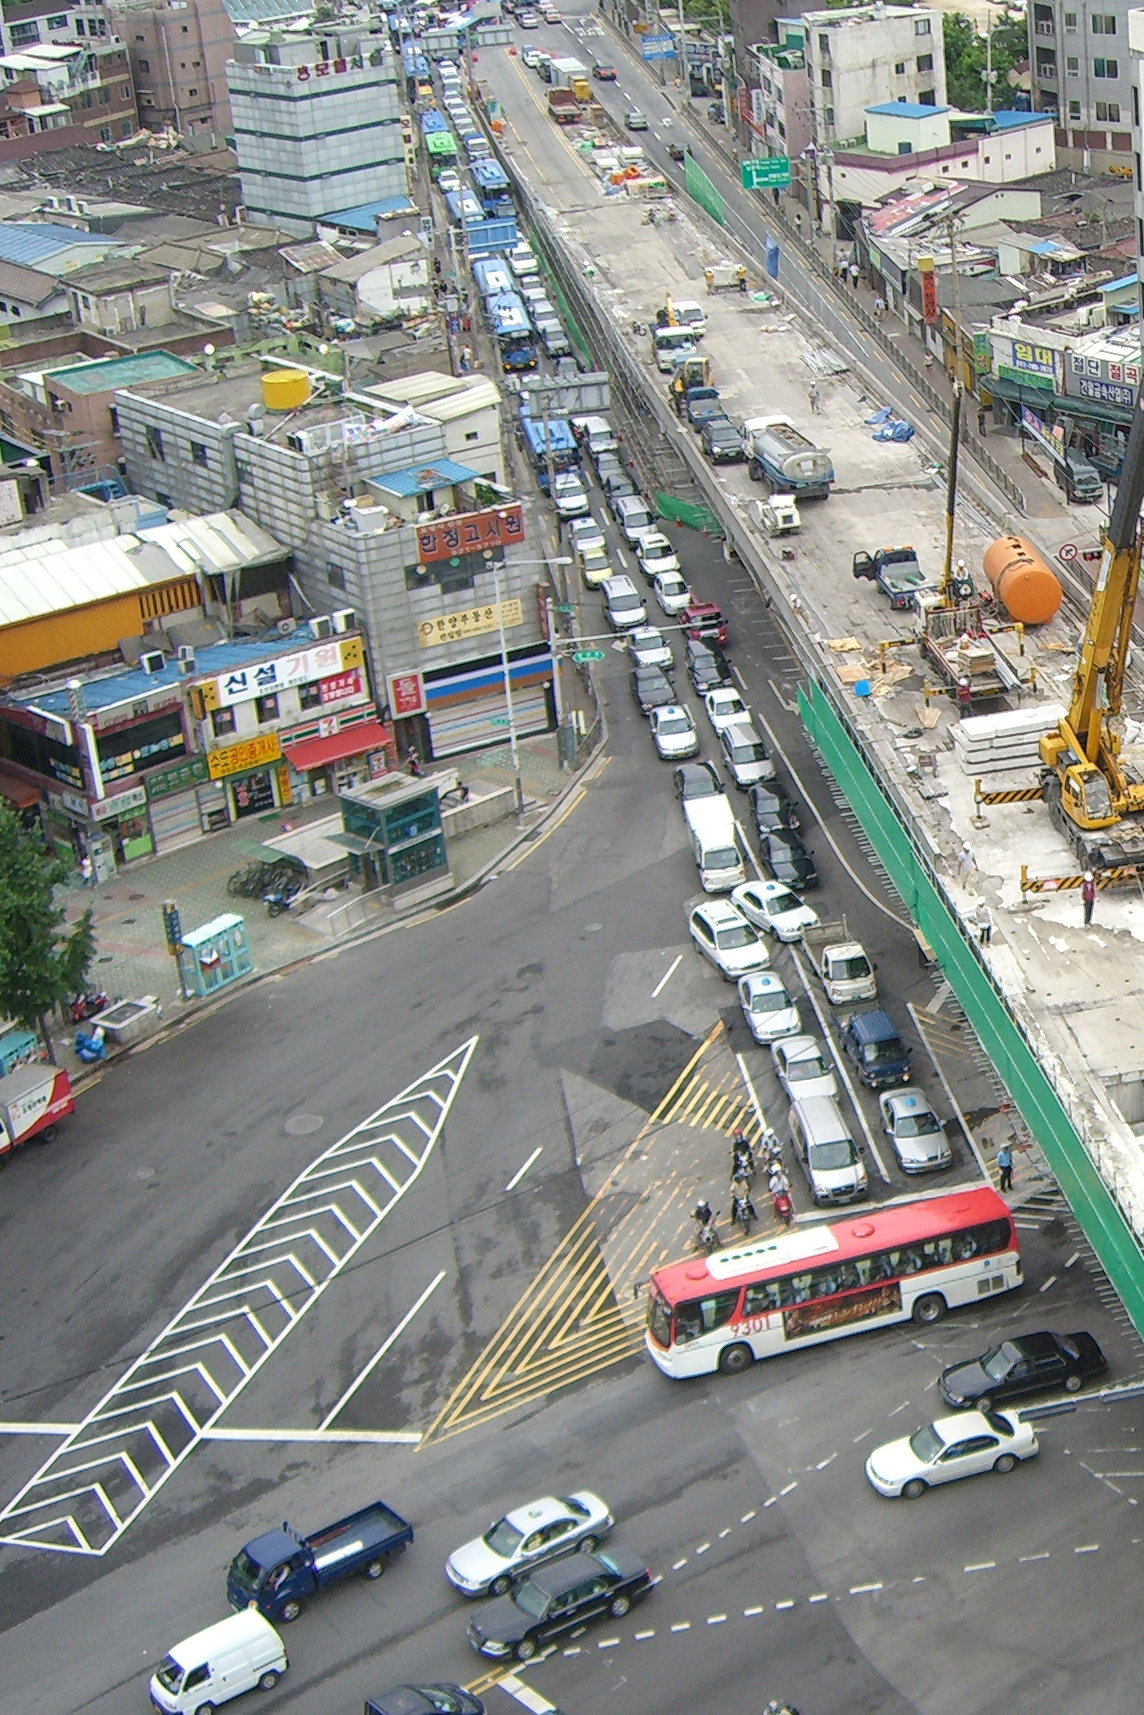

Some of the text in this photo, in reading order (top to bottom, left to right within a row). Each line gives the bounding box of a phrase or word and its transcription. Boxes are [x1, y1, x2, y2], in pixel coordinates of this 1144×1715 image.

[1014, 343, 1053, 366] 임대
[419, 513, 522, 554] 한정고시원
[224, 663, 278, 696] 신설
[286, 645, 338, 678] 기원
[729, 1316, 771, 1338] 9301
